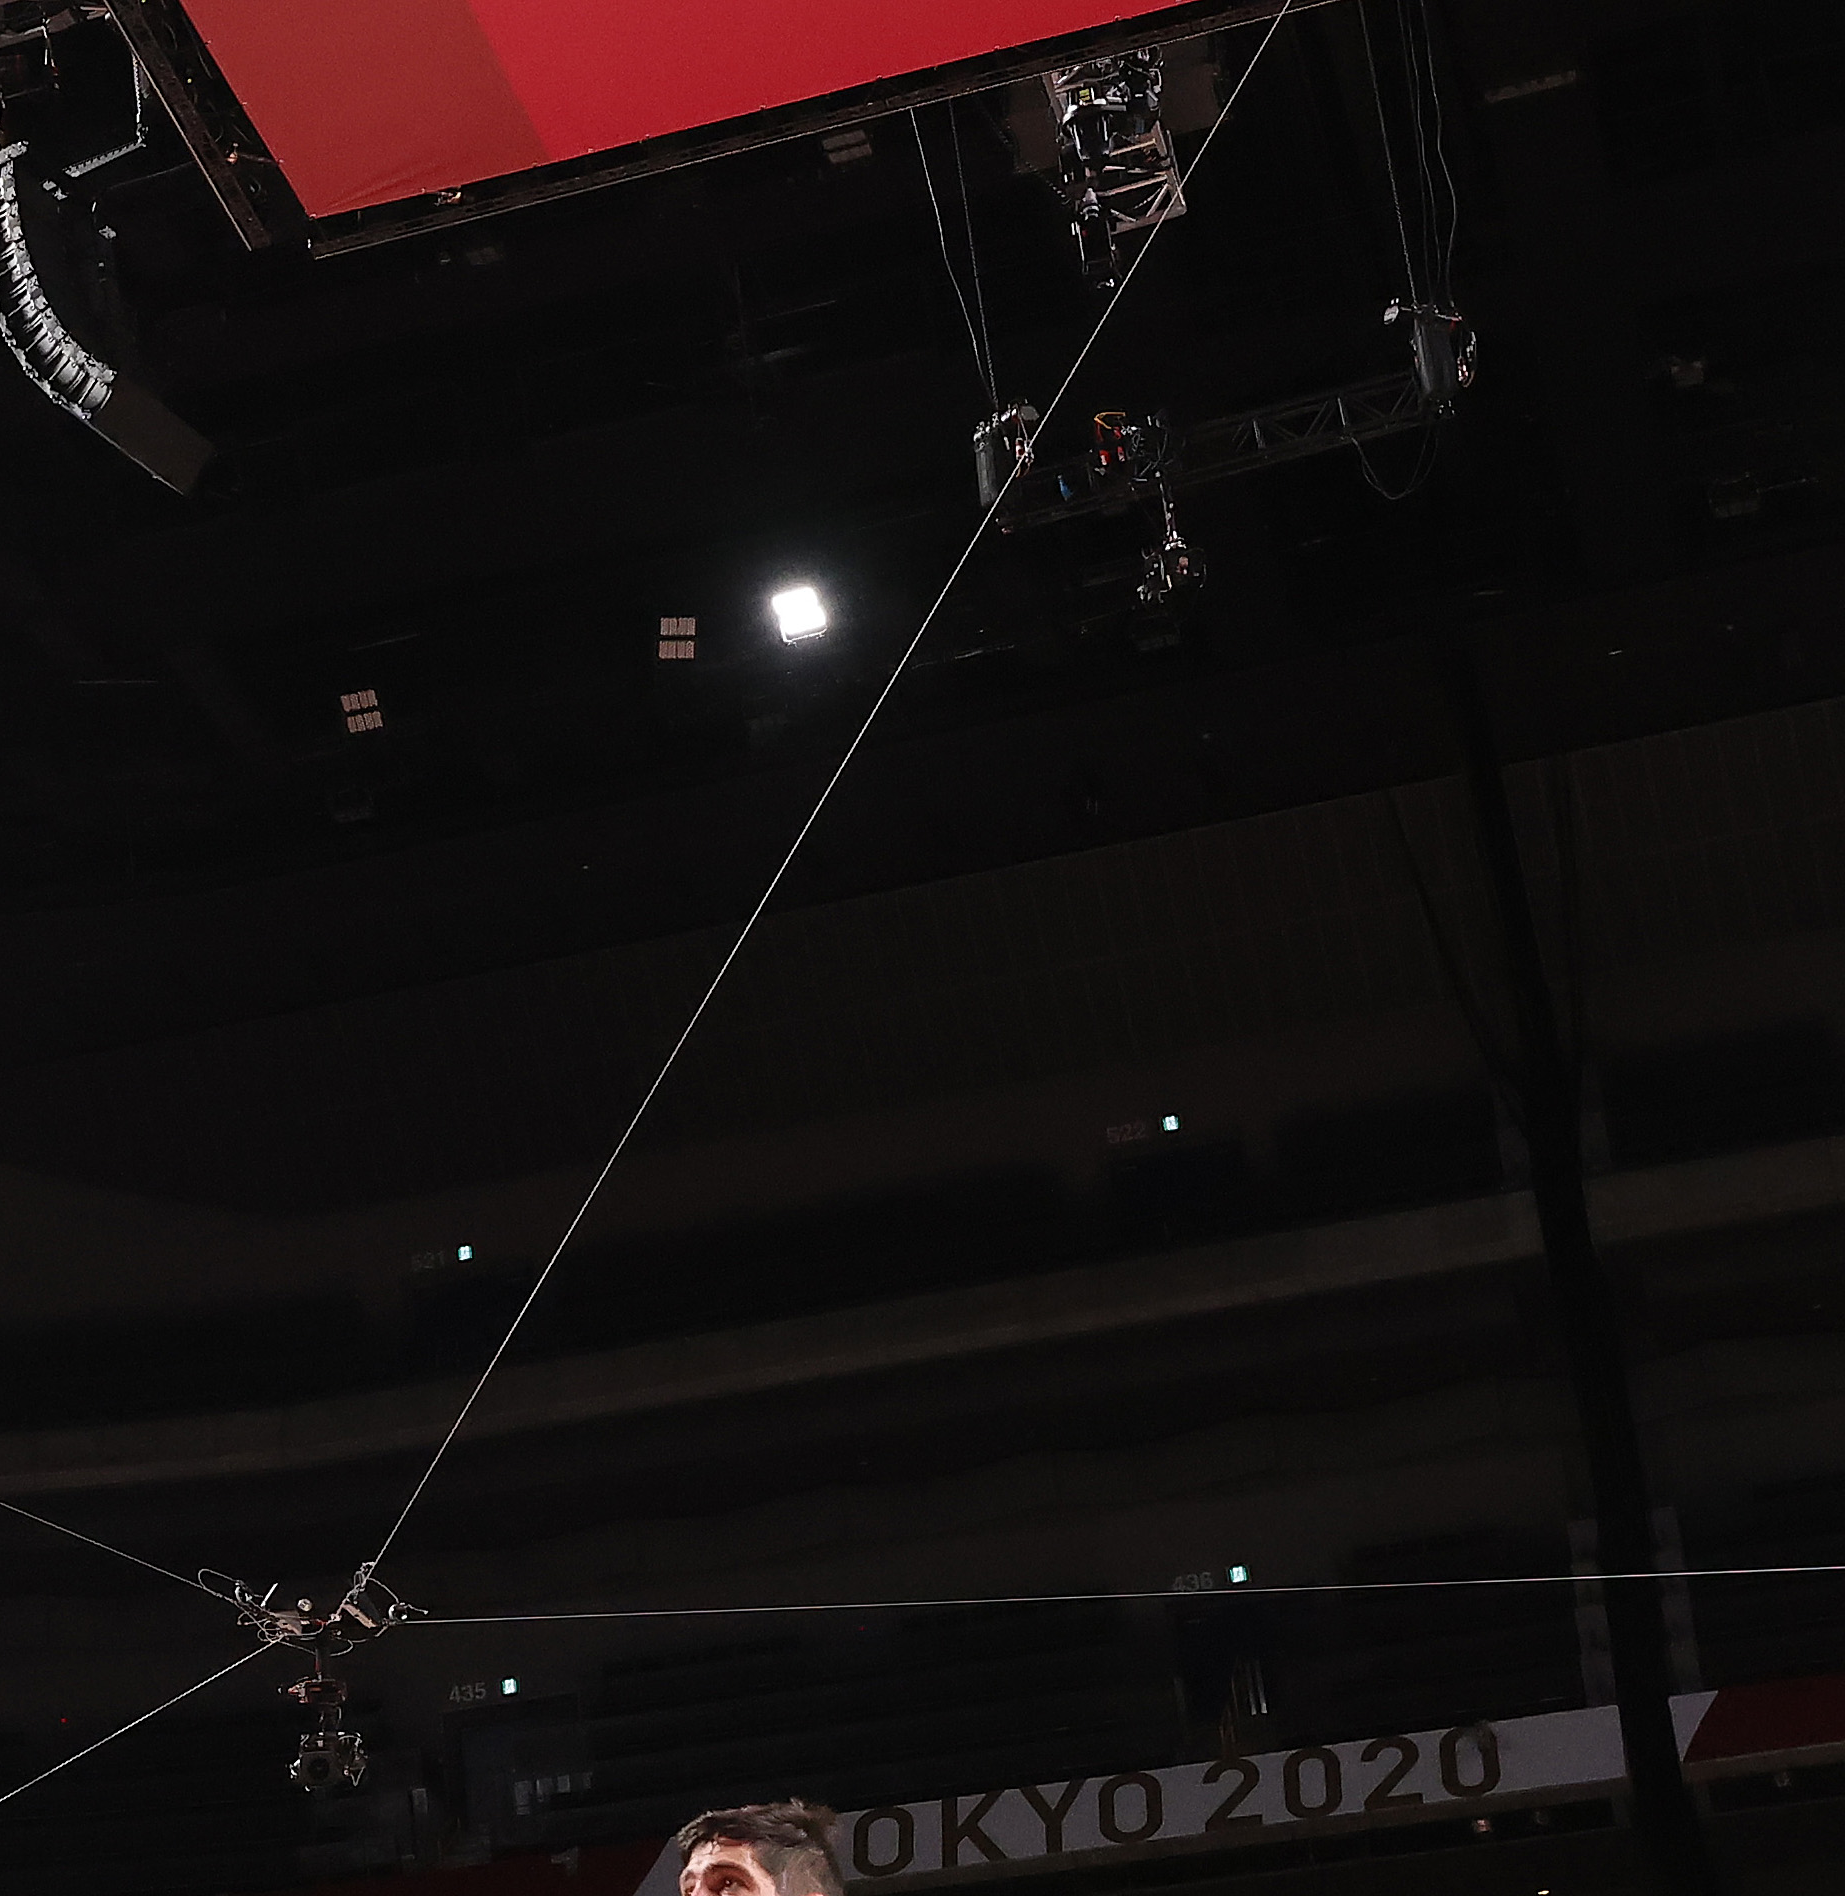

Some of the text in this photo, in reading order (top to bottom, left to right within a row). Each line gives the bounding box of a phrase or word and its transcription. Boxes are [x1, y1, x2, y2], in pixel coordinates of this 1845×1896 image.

[449, 1682, 487, 1703] 435
[854, 1724, 1502, 1877] OKYO 2020
